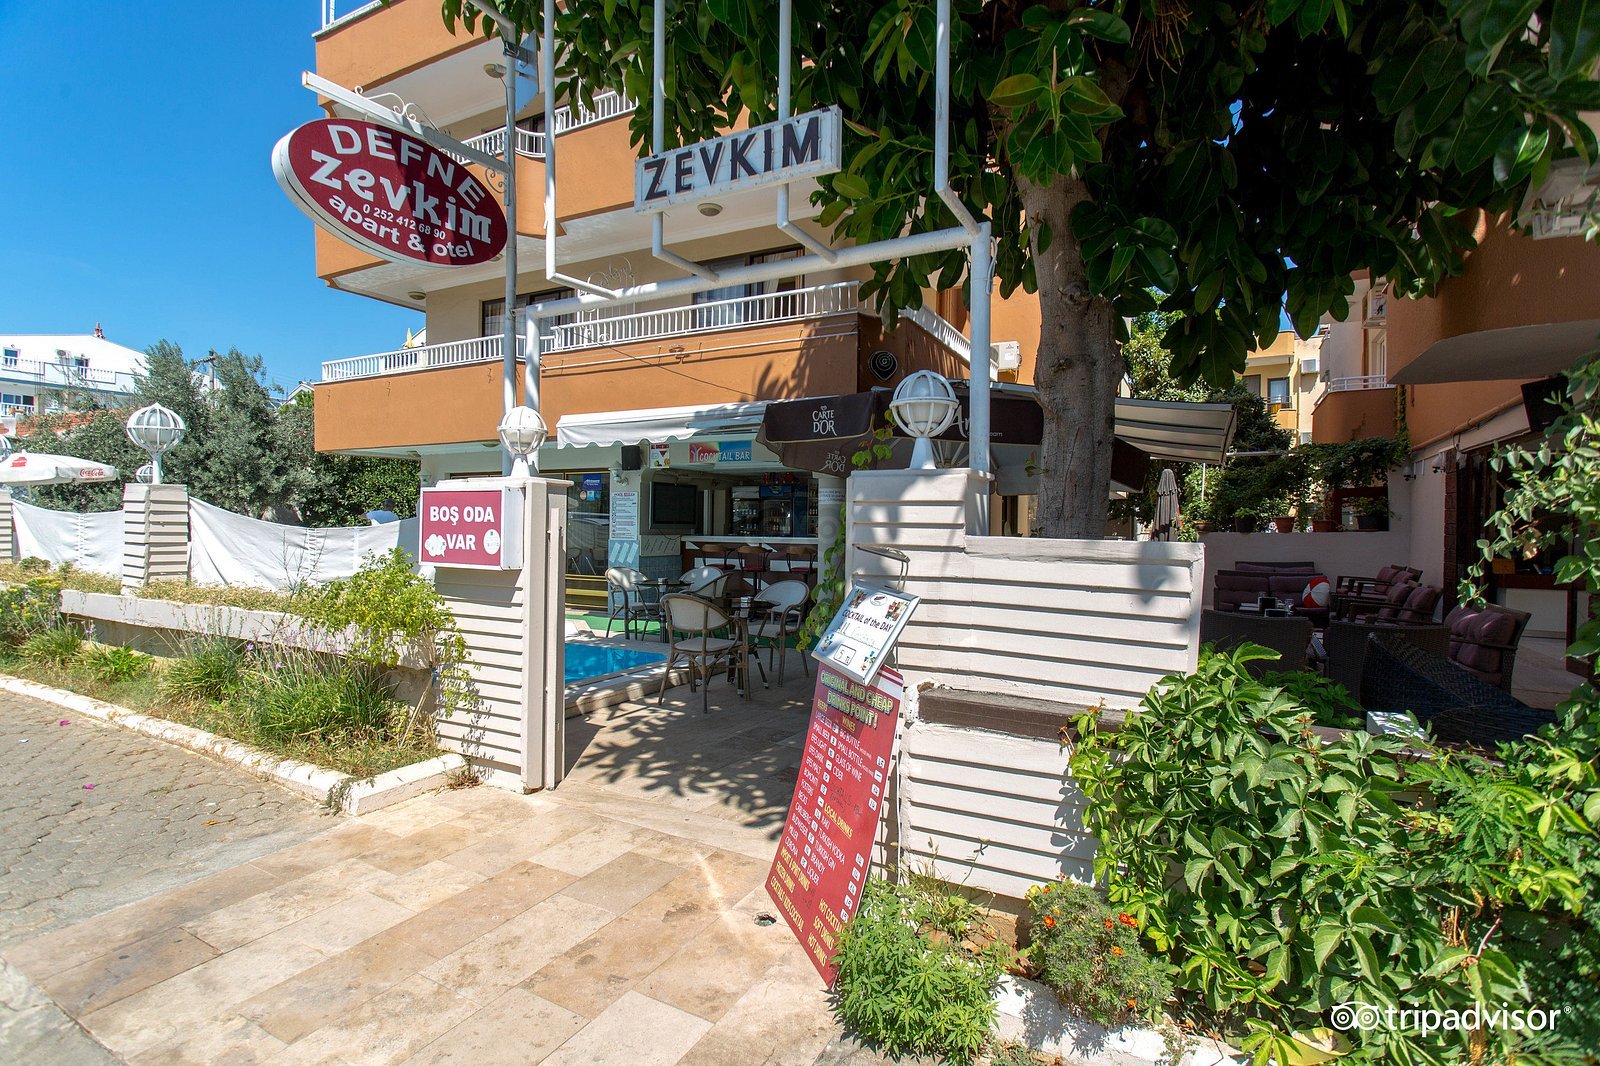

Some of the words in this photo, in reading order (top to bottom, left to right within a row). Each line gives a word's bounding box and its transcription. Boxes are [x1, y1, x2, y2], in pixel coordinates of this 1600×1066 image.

[327, 124, 486, 209] DEFNE
[644, 116, 820, 201] ZEVKIM
[328, 194, 401, 245] apart
[407, 233, 426, 254] &
[433, 240, 475, 258] otel
[363, 203, 369, 214] 0
[373, 207, 394, 223] 252
[396, 215, 416, 231] 412
[418, 223, 431, 235] 68
[433, 228, 446, 240] 90
[812, 410, 834, 422] CARTE
[700, 451, 732, 462] COCKTAIL
[736, 451, 750, 461] BAR
[429, 505, 459, 526] BOŞ
[463, 506, 495, 523] ODA
[446, 534, 476, 550] VAR
[842, 609, 863, 623] COCKTAIL
[870, 618, 880, 628] the
[880, 621, 894, 632] DAY
[827, 691, 850, 713] DRINKS
[849, 685, 866, 701] AND
[866, 691, 893, 715] CHEAP
[842, 717, 856, 731] WINES
[845, 733, 860, 749] BOTTLE
[836, 740, 848, 755] SMALL
[847, 749, 862, 766] BOTTLE
[835, 754, 846, 767] GLASS
[845, 762, 852, 772] OF
[851, 767, 862, 781] WINE
[824, 802, 837, 821] LOCAL
[837, 816, 853, 837] DRINKS
[831, 843, 845, 864] VODKA
